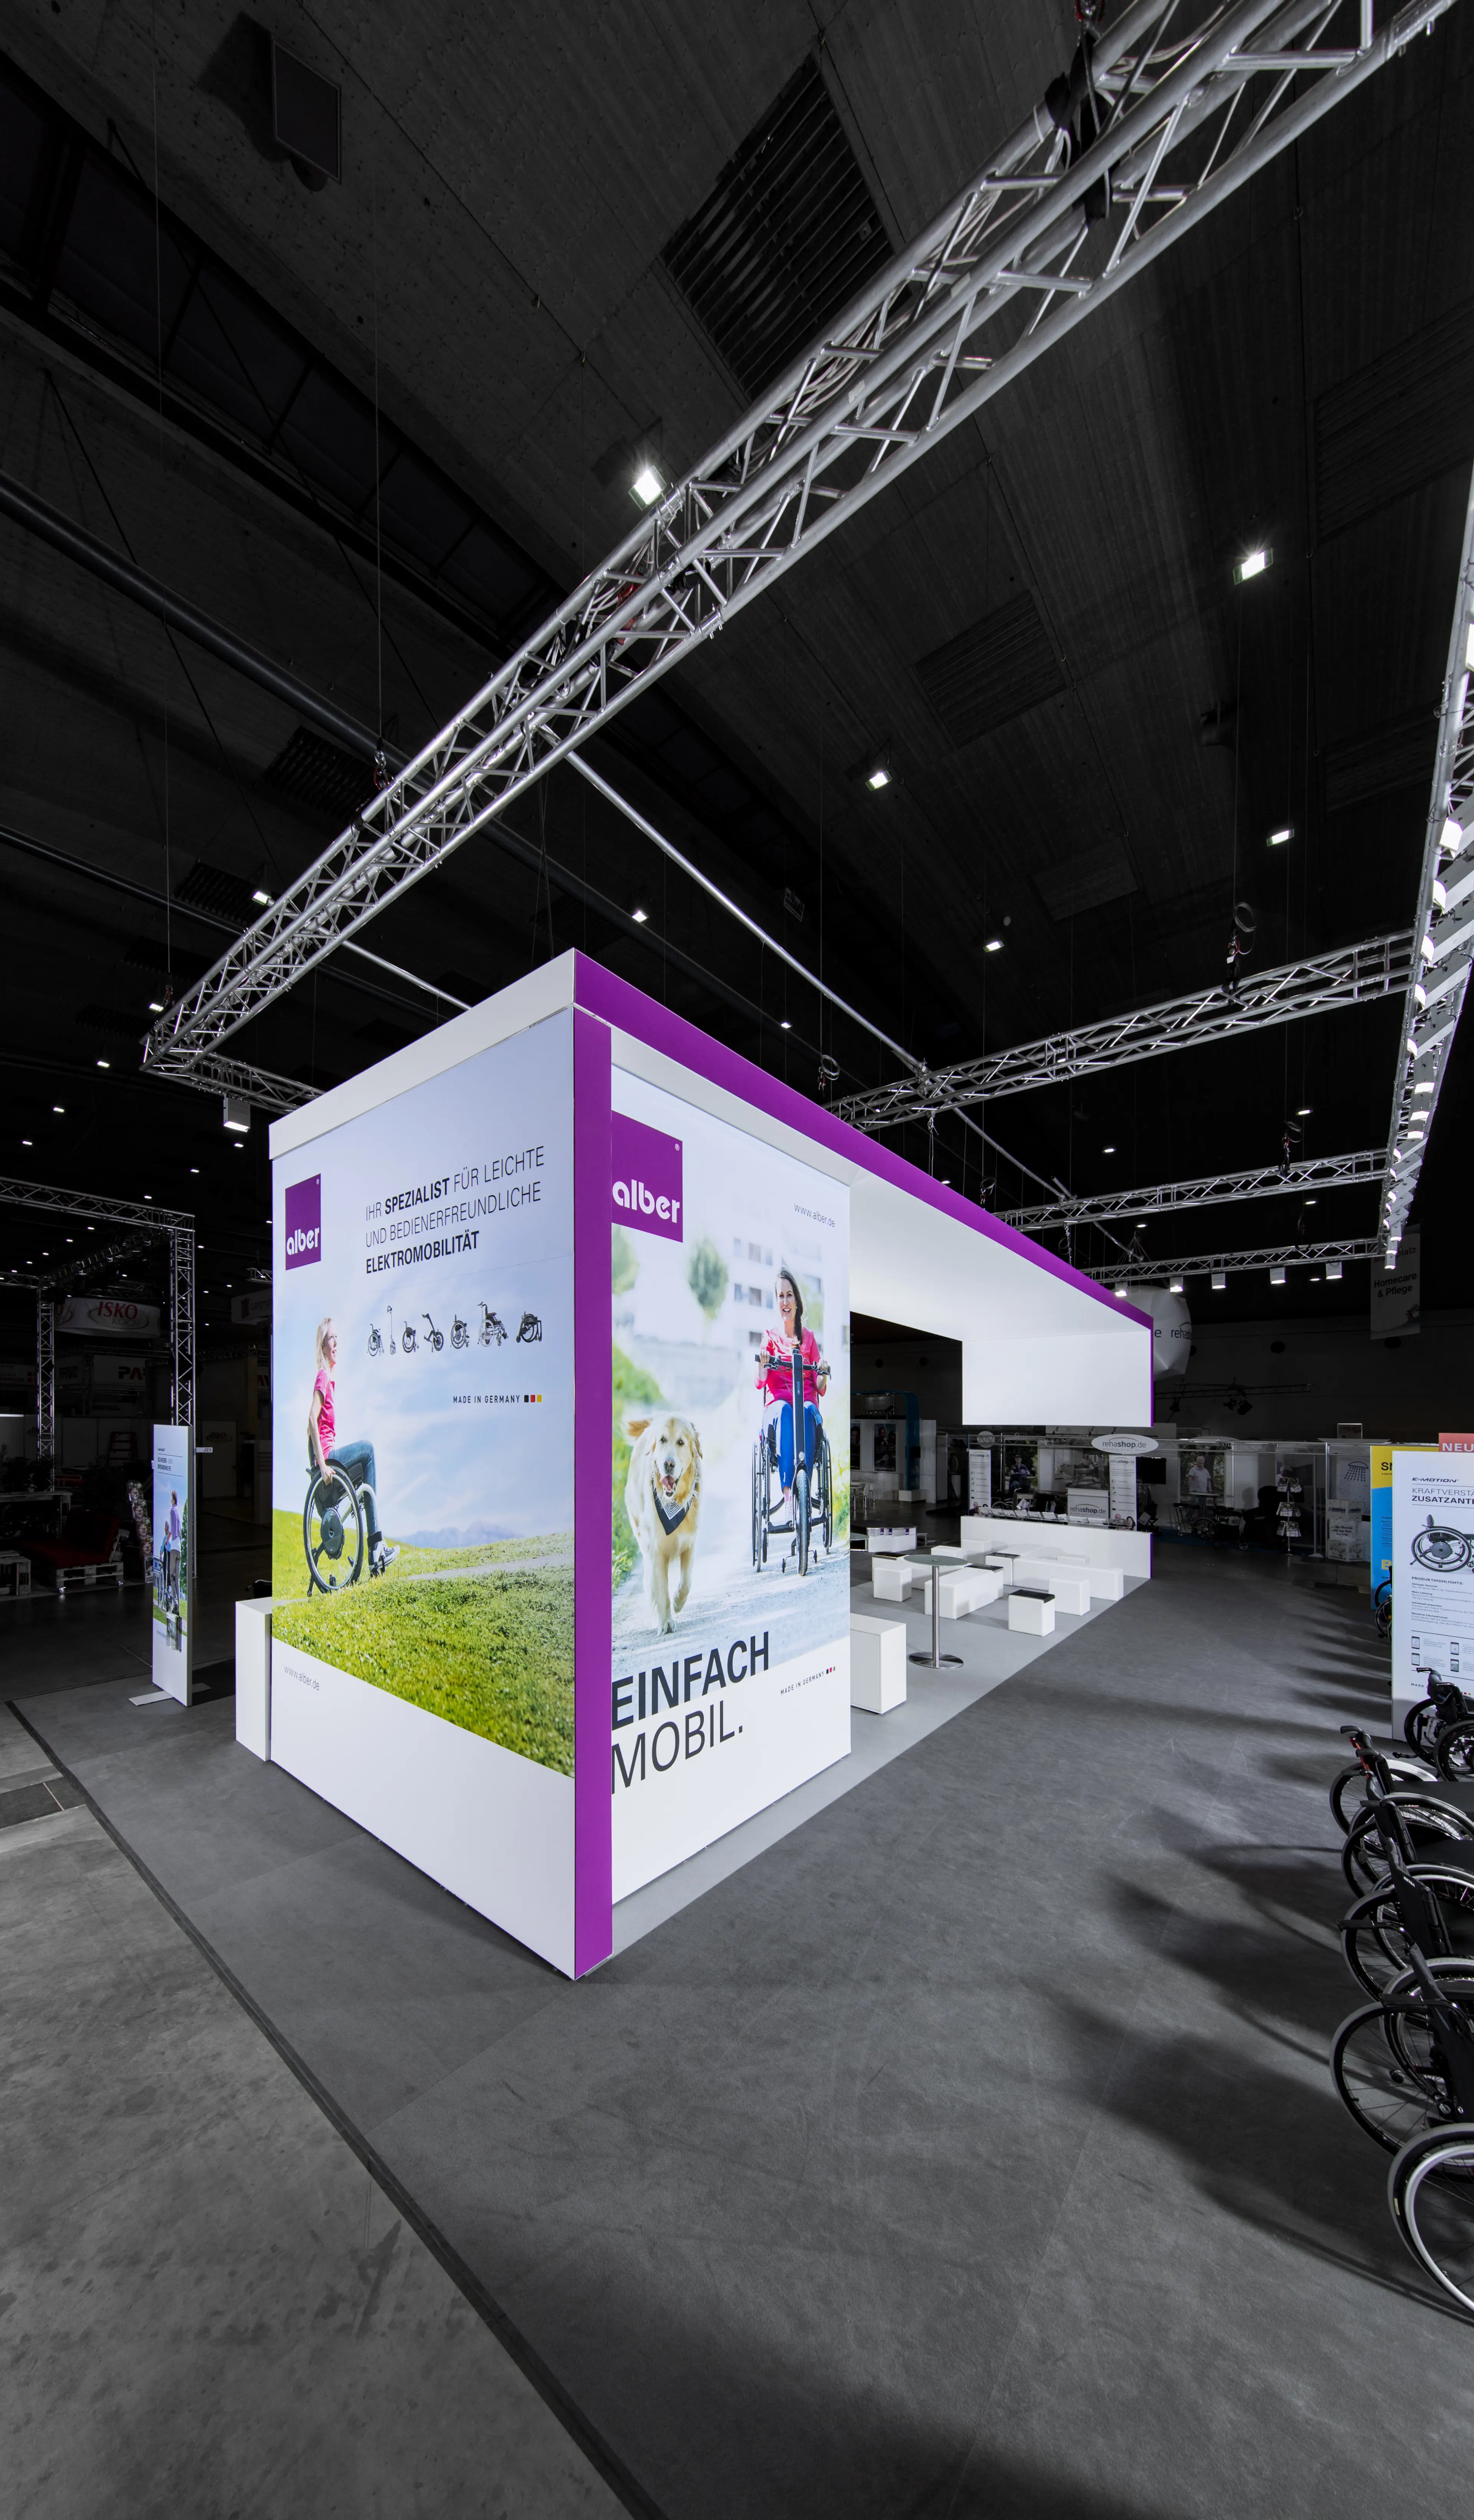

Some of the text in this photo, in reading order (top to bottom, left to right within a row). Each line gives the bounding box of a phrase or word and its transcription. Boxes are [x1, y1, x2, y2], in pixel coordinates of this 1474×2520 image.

[366, 1146, 544, 1221] IHR SPEZIALIST FÜR LEICHTE
[612, 1179, 680, 1224] alber
[365, 1181, 541, 1248] UND BEDIENERFREUNDLICHE
[793, 1203, 836, 1228] www.alber.de
[286, 1227, 320, 1256] alber
[366, 1230, 479, 1274] ELEKTROMOBILITÄT
[1374, 1247, 1416, 1263] Maplatz
[1374, 1273, 1417, 1288] Homecare
[1378, 1285, 1413, 1298] & Pflege
[97, 1301, 138, 1319] ISKO
[1171, 1328, 1191, 1340] rehas
[119, 1366, 145, 1380] PA
[453, 1394, 520, 1404] MADE IN GERMANY
[1102, 1440, 1147, 1449] rehashop.de
[1442, 1443, 1474, 1452] NEU
[1070, 1506, 1106, 1514] rehashop.de
[284, 1665, 320, 1691] www.alber.de
[612, 1631, 769, 1731] EINFACH
[780, 1685, 794, 1696] MADE
[802, 1671, 825, 1686] GERMANY
[612, 1700, 743, 1795] MOBIL.
